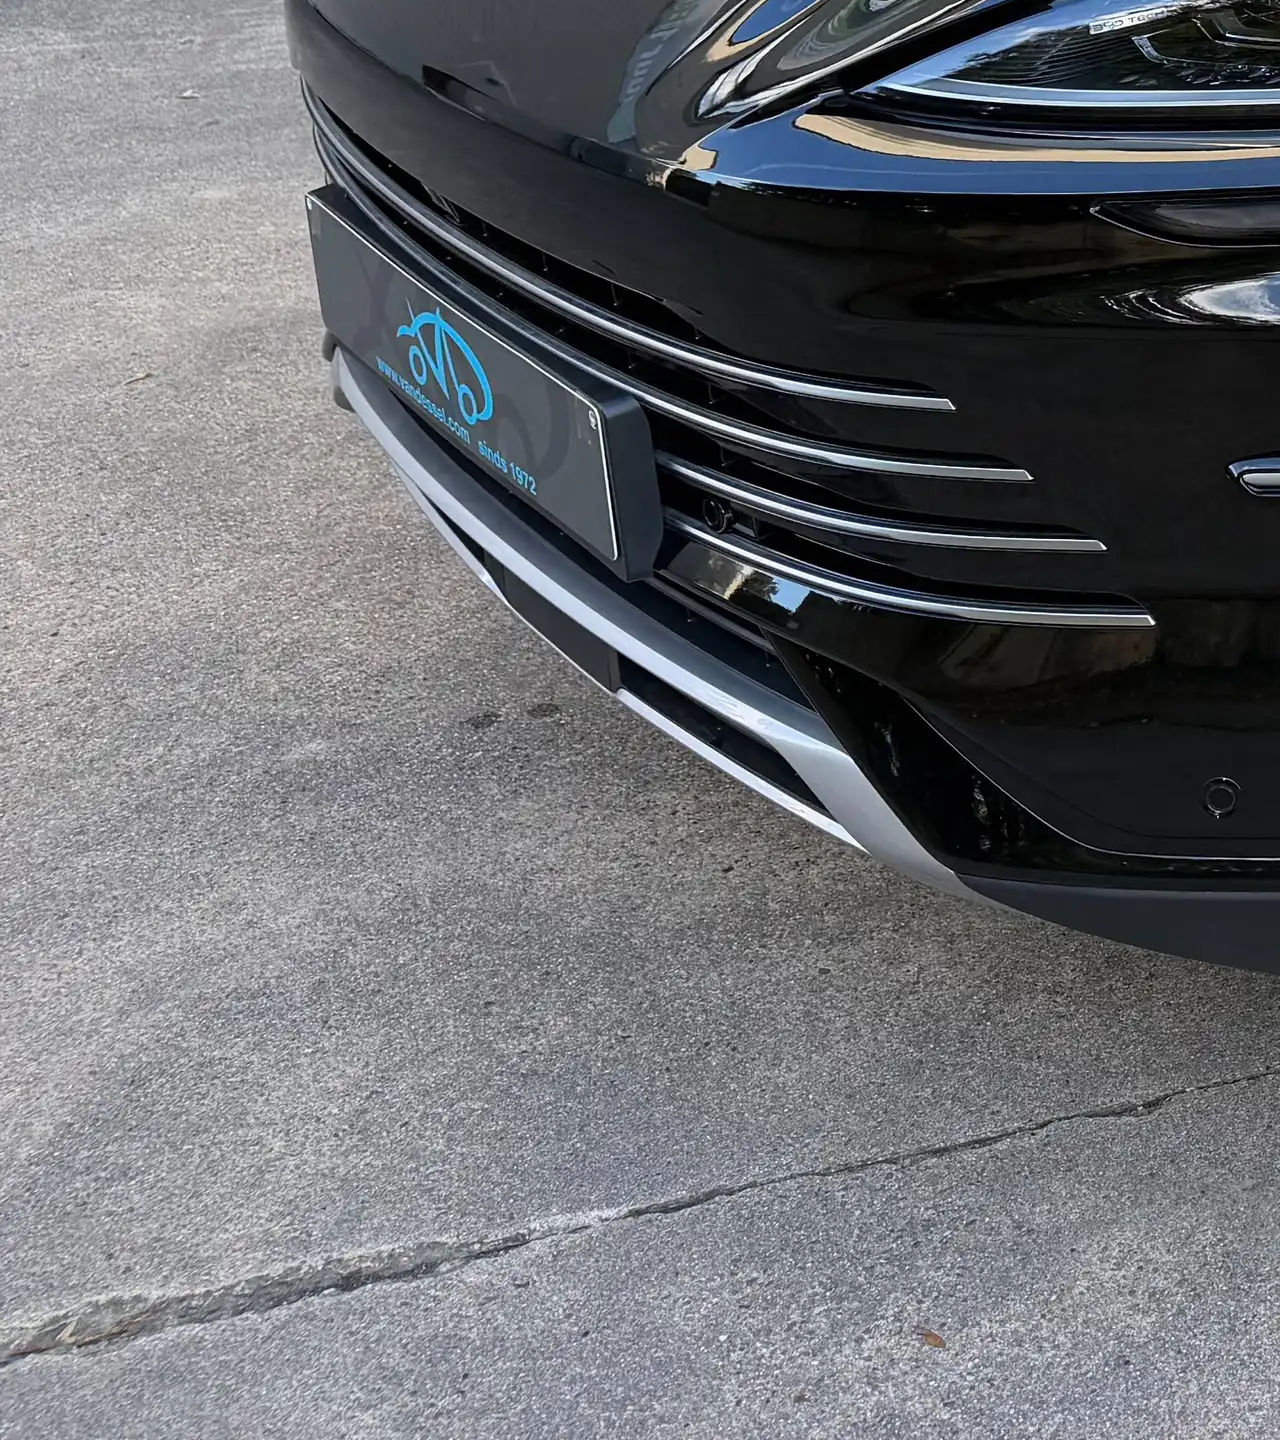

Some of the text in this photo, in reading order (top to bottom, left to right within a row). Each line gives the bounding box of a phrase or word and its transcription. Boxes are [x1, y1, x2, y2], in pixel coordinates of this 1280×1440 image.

[375, 355, 538, 496] www.vandessel.com sinds 1972
